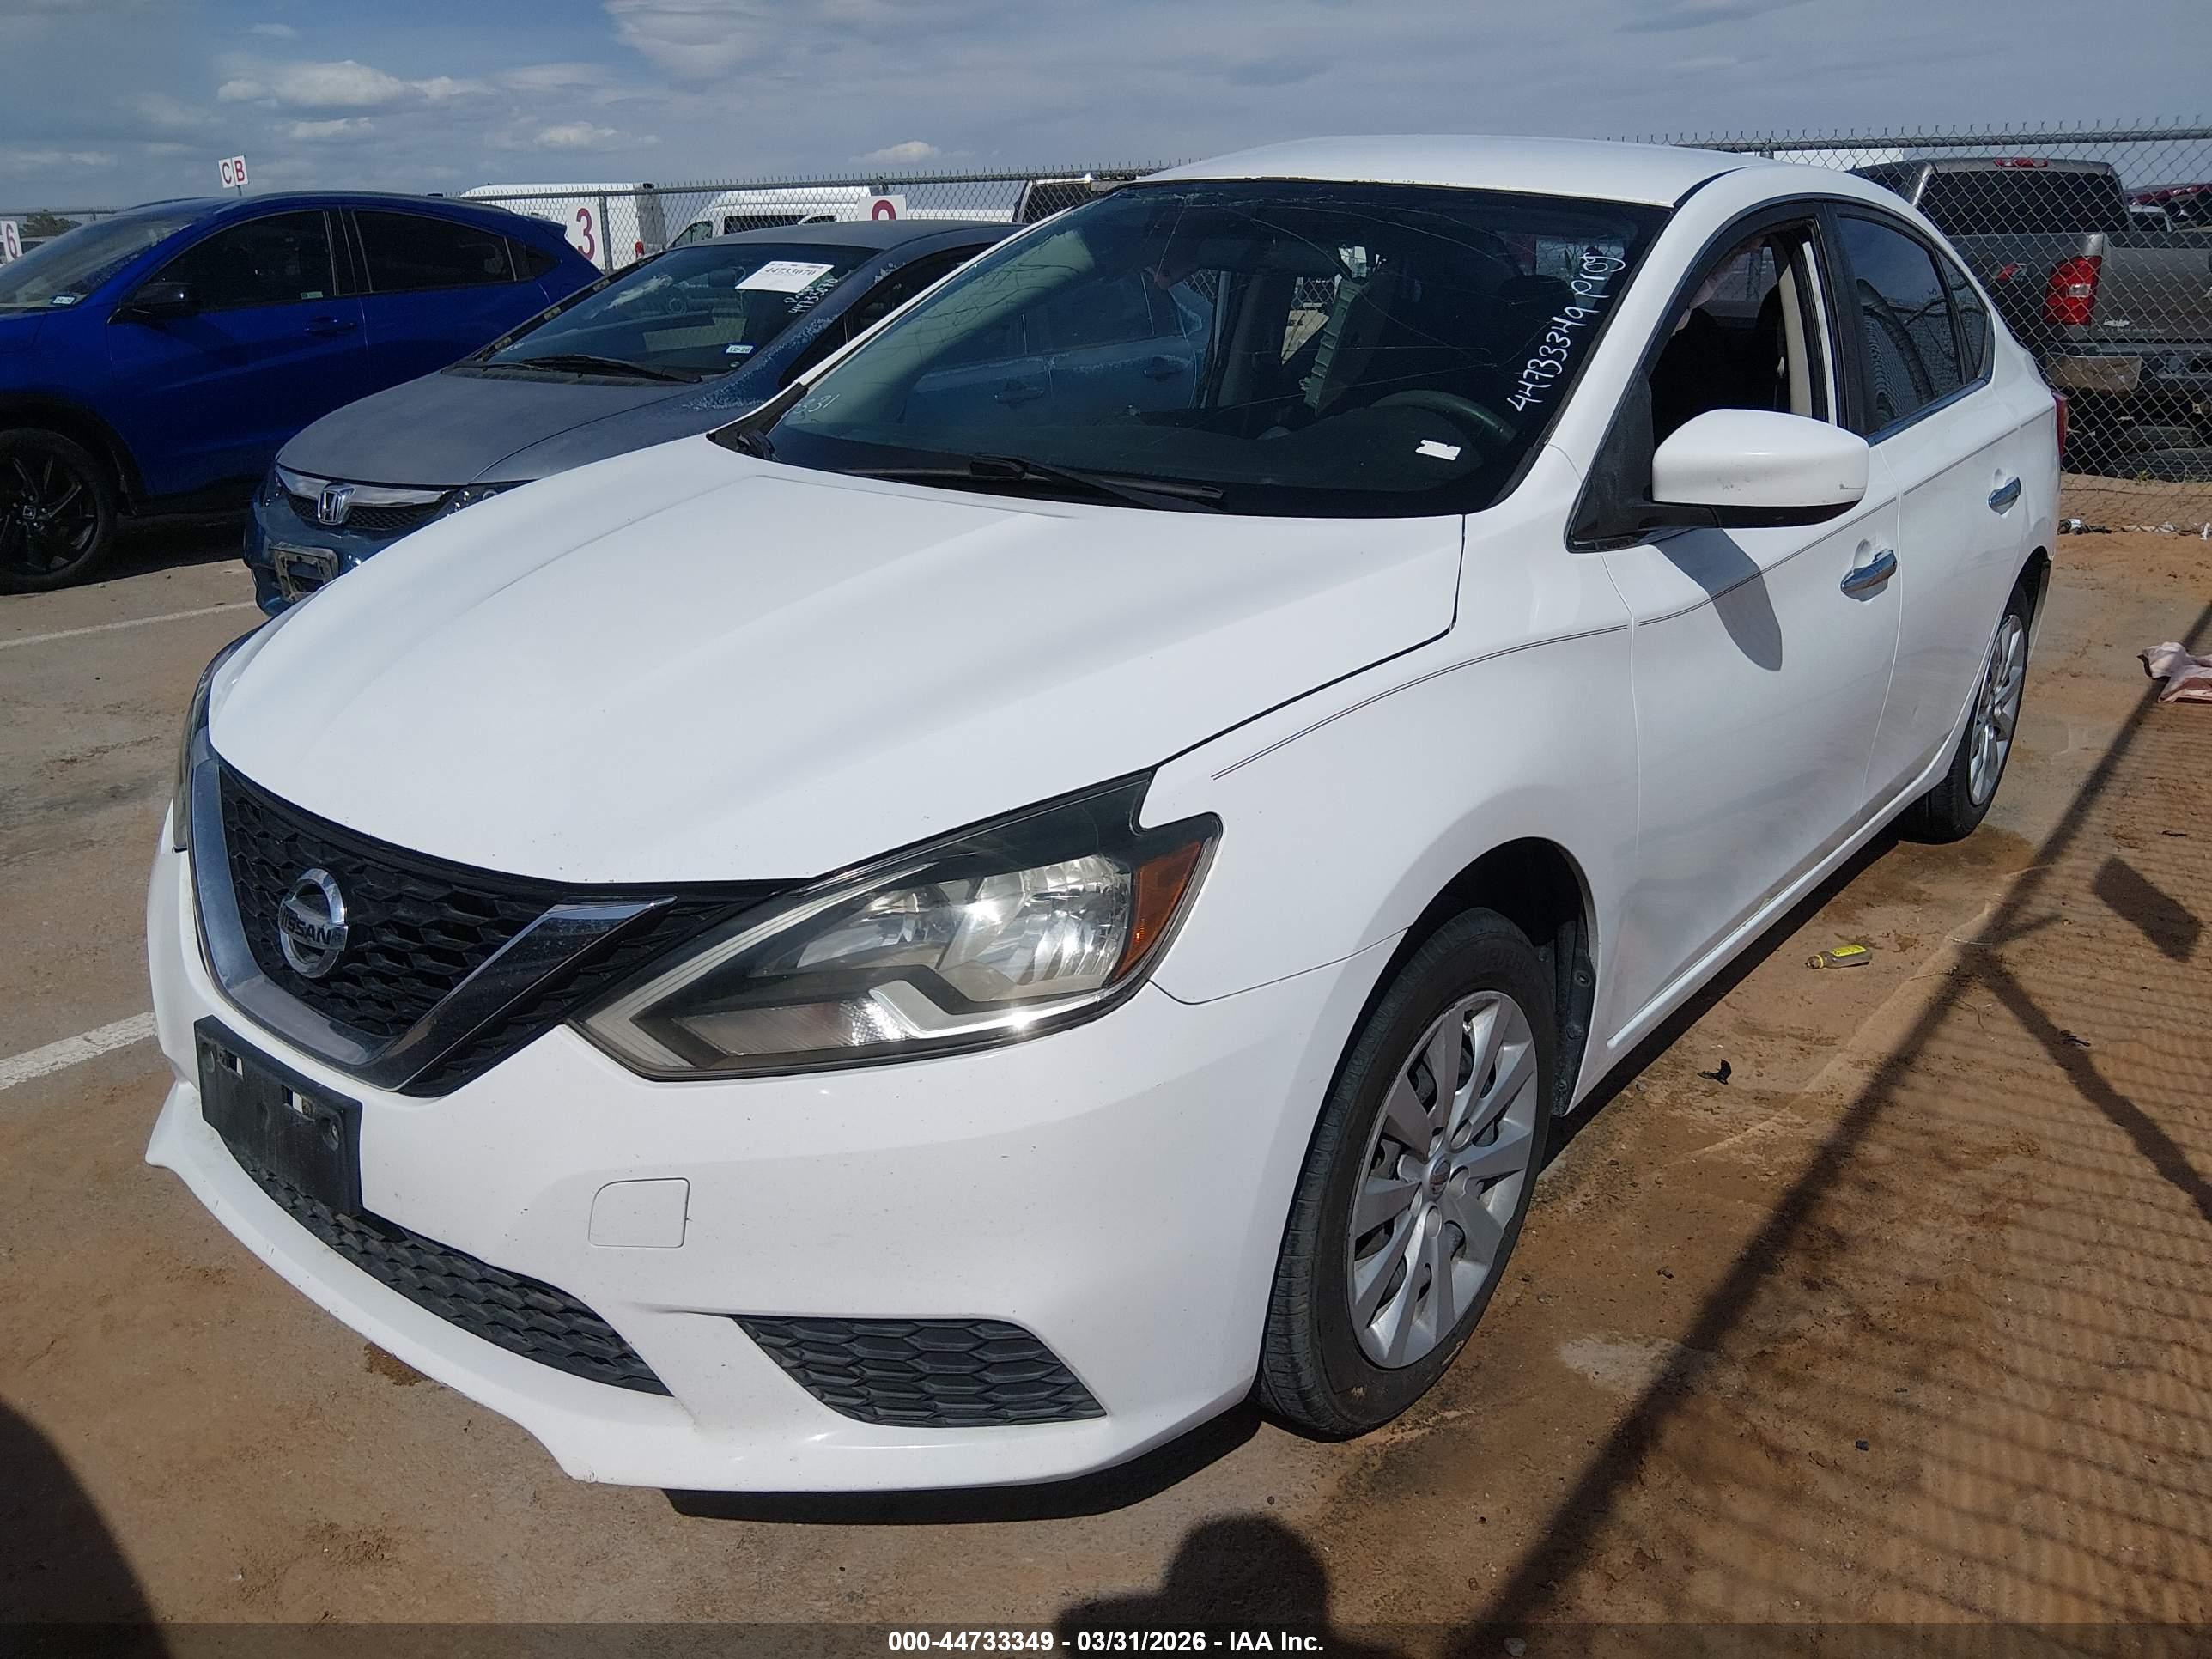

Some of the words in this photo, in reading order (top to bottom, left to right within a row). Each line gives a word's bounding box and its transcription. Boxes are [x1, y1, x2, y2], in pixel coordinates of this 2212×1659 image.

[222, 160, 246, 185] CB
[6, 223, 18, 259] 6
[576, 207, 595, 261] 3
[1506, 306, 1601, 412] 44733349
[279, 902, 332, 945] NISSAN
